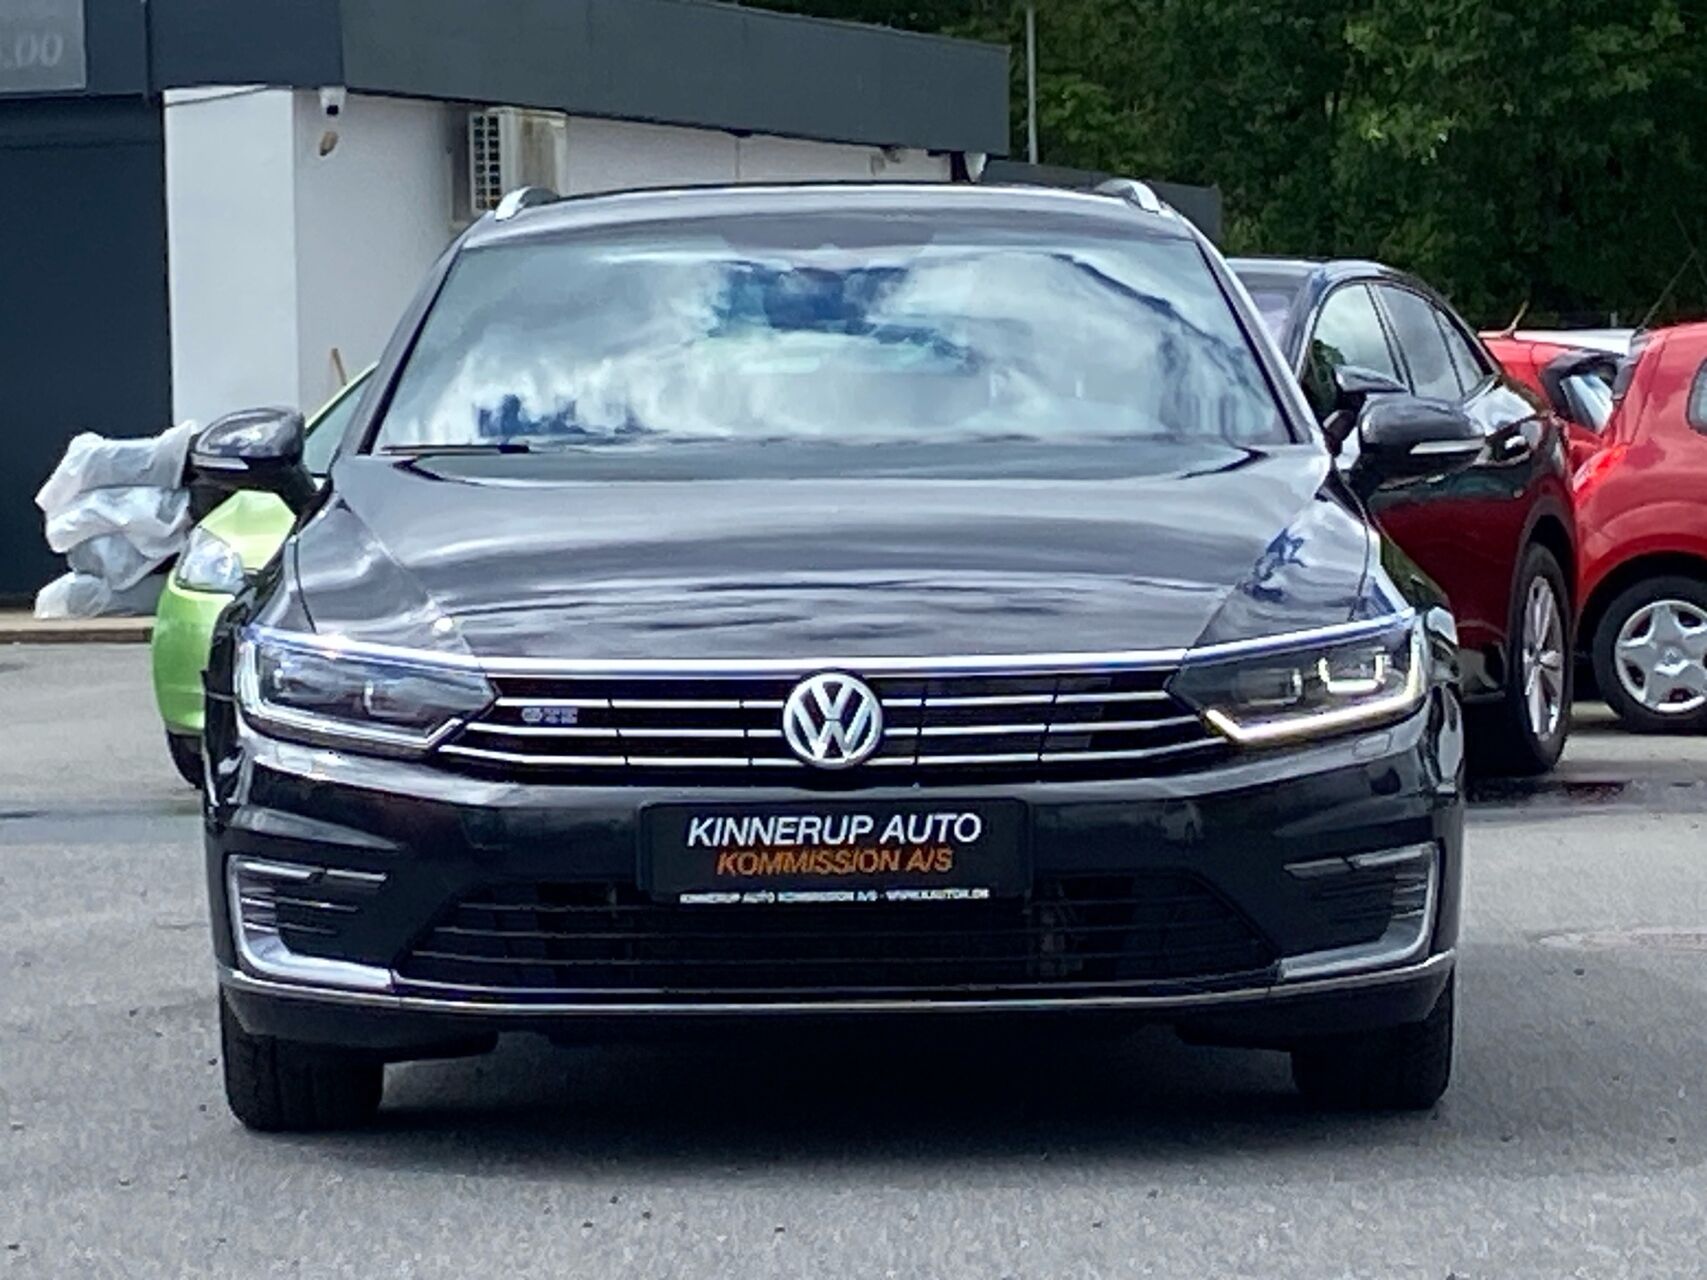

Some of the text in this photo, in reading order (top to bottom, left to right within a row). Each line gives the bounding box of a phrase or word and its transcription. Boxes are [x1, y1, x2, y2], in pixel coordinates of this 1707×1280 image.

[686, 811, 984, 849] KINNERUP AUTO
[715, 847, 954, 877] KOMMISSION A/S
